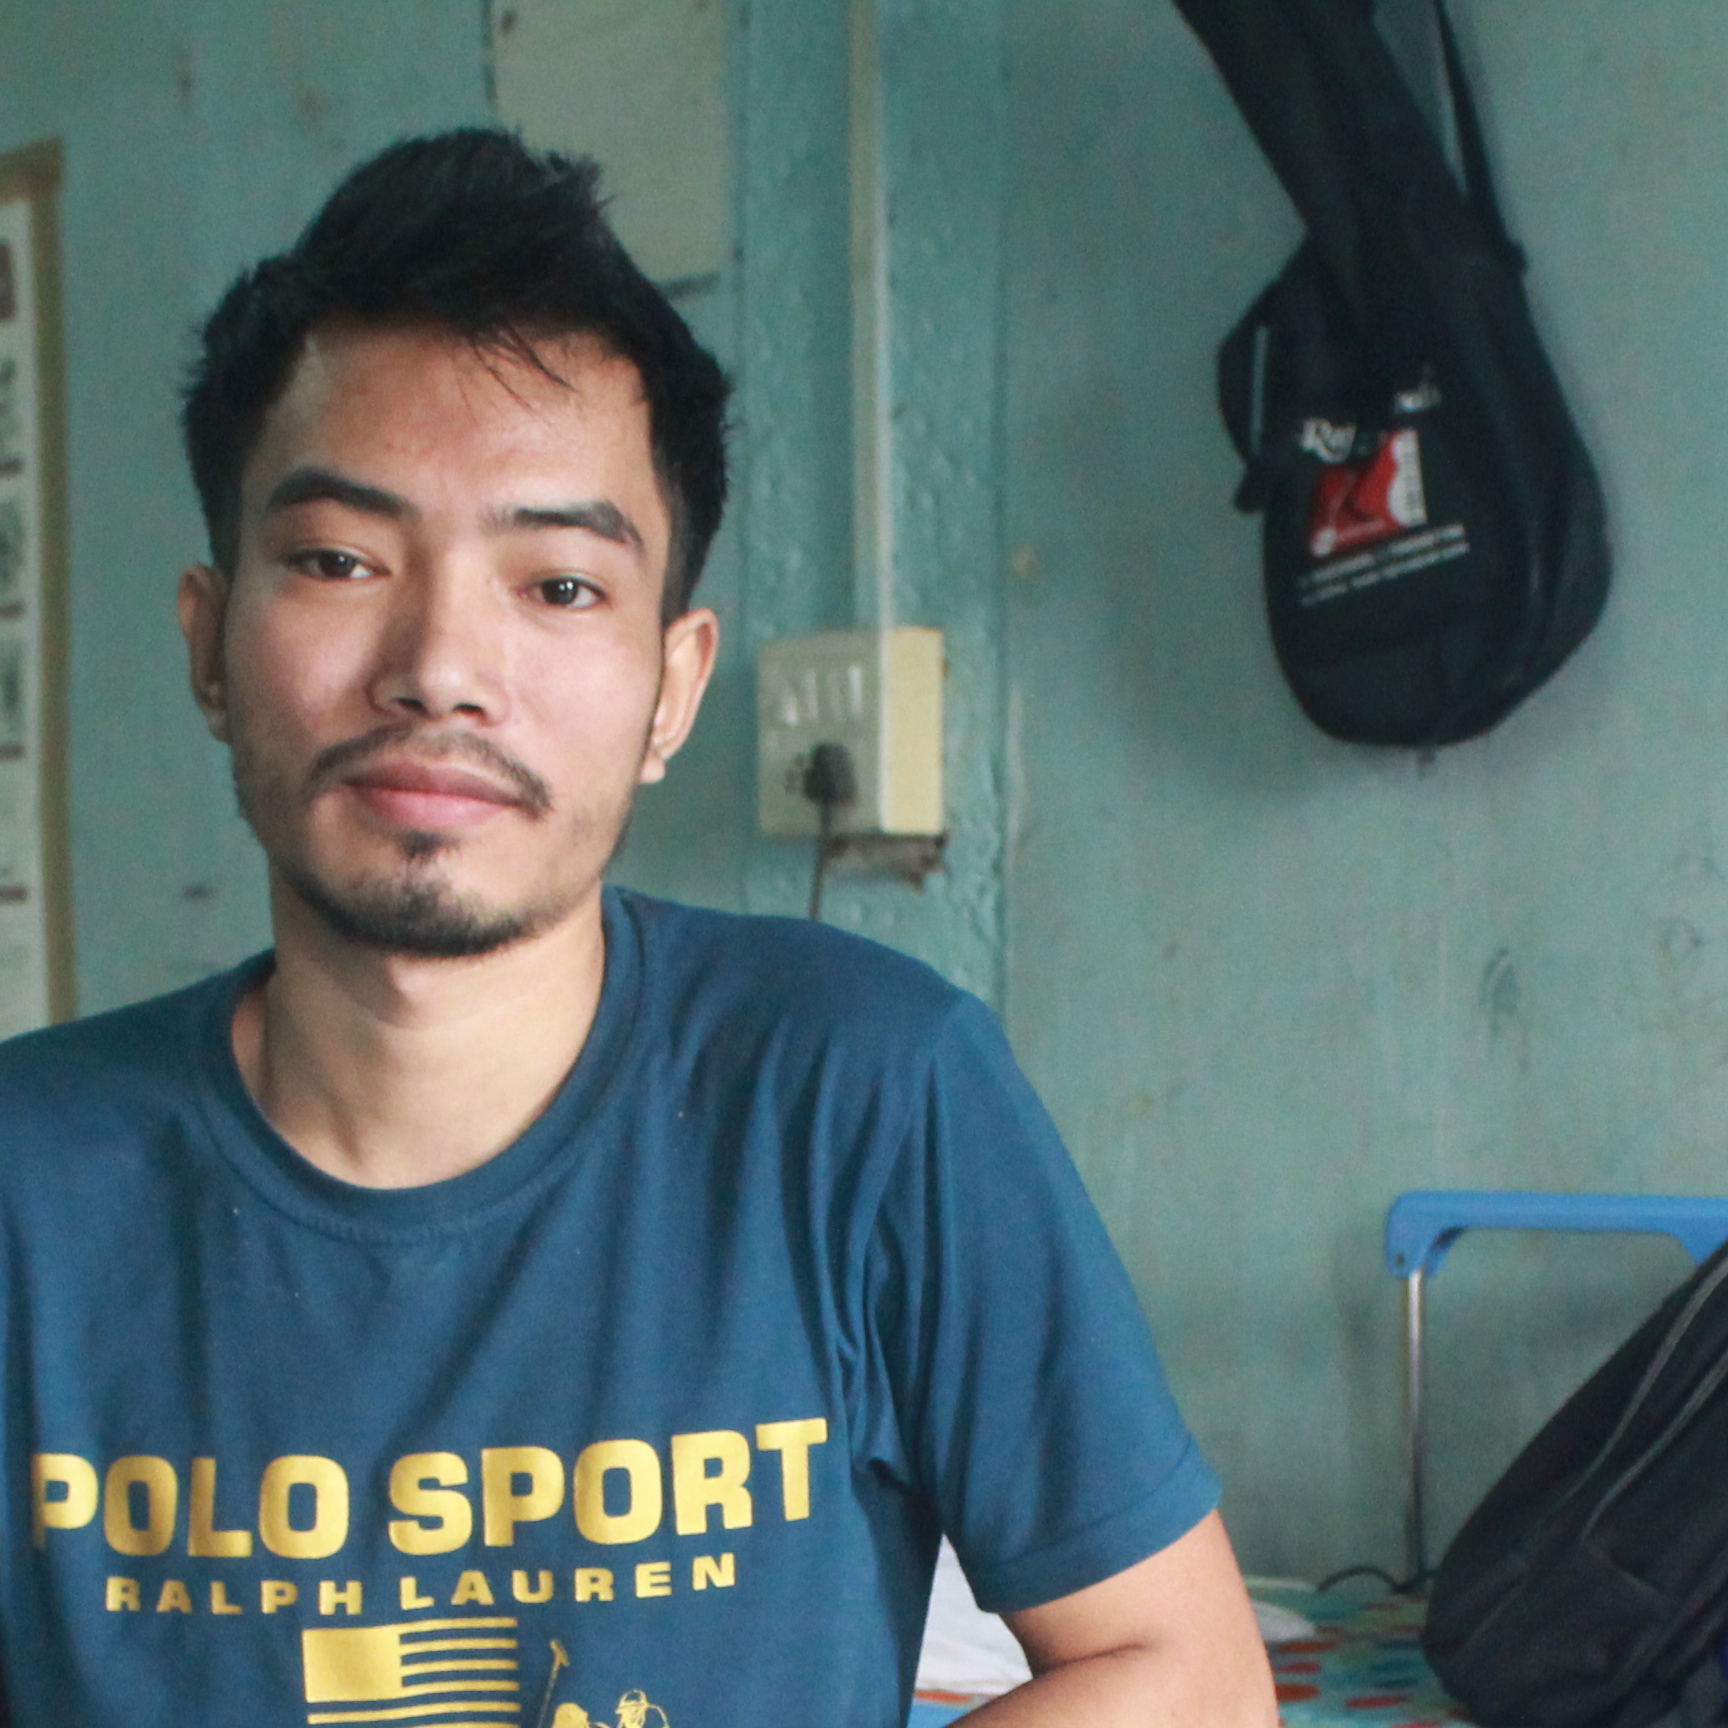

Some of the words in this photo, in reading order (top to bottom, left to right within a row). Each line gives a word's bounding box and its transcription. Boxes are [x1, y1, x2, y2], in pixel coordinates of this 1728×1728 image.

[32, 1453, 350, 1560] POLO
[387, 1417, 829, 1556] SPORT
[105, 1576, 363, 1615] RALPH
[399, 1552, 737, 1610] LAUREN
